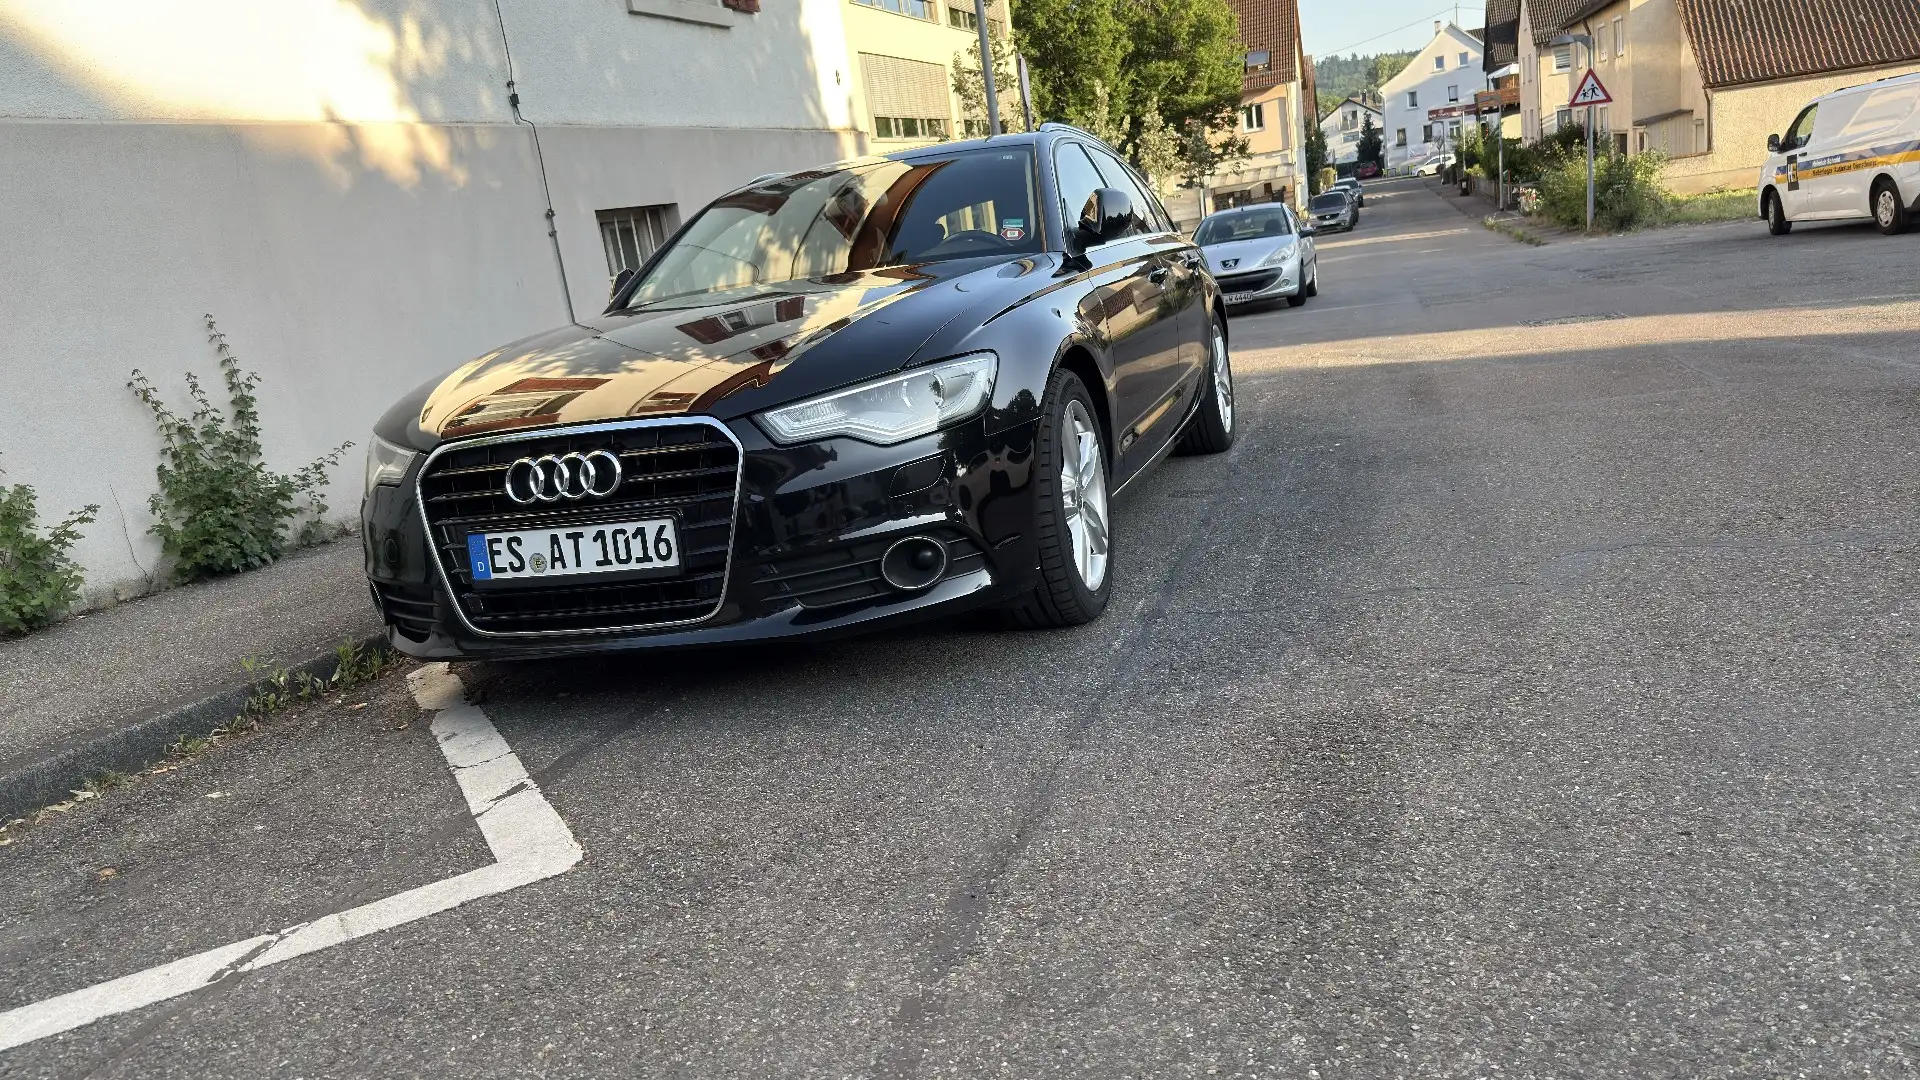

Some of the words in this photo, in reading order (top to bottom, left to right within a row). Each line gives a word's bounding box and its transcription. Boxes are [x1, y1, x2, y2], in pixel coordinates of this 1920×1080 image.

[487, 536, 526, 573] ES
[550, 531, 584, 569] AT
[592, 525, 673, 566] 1016
[477, 561, 485, 572] D
